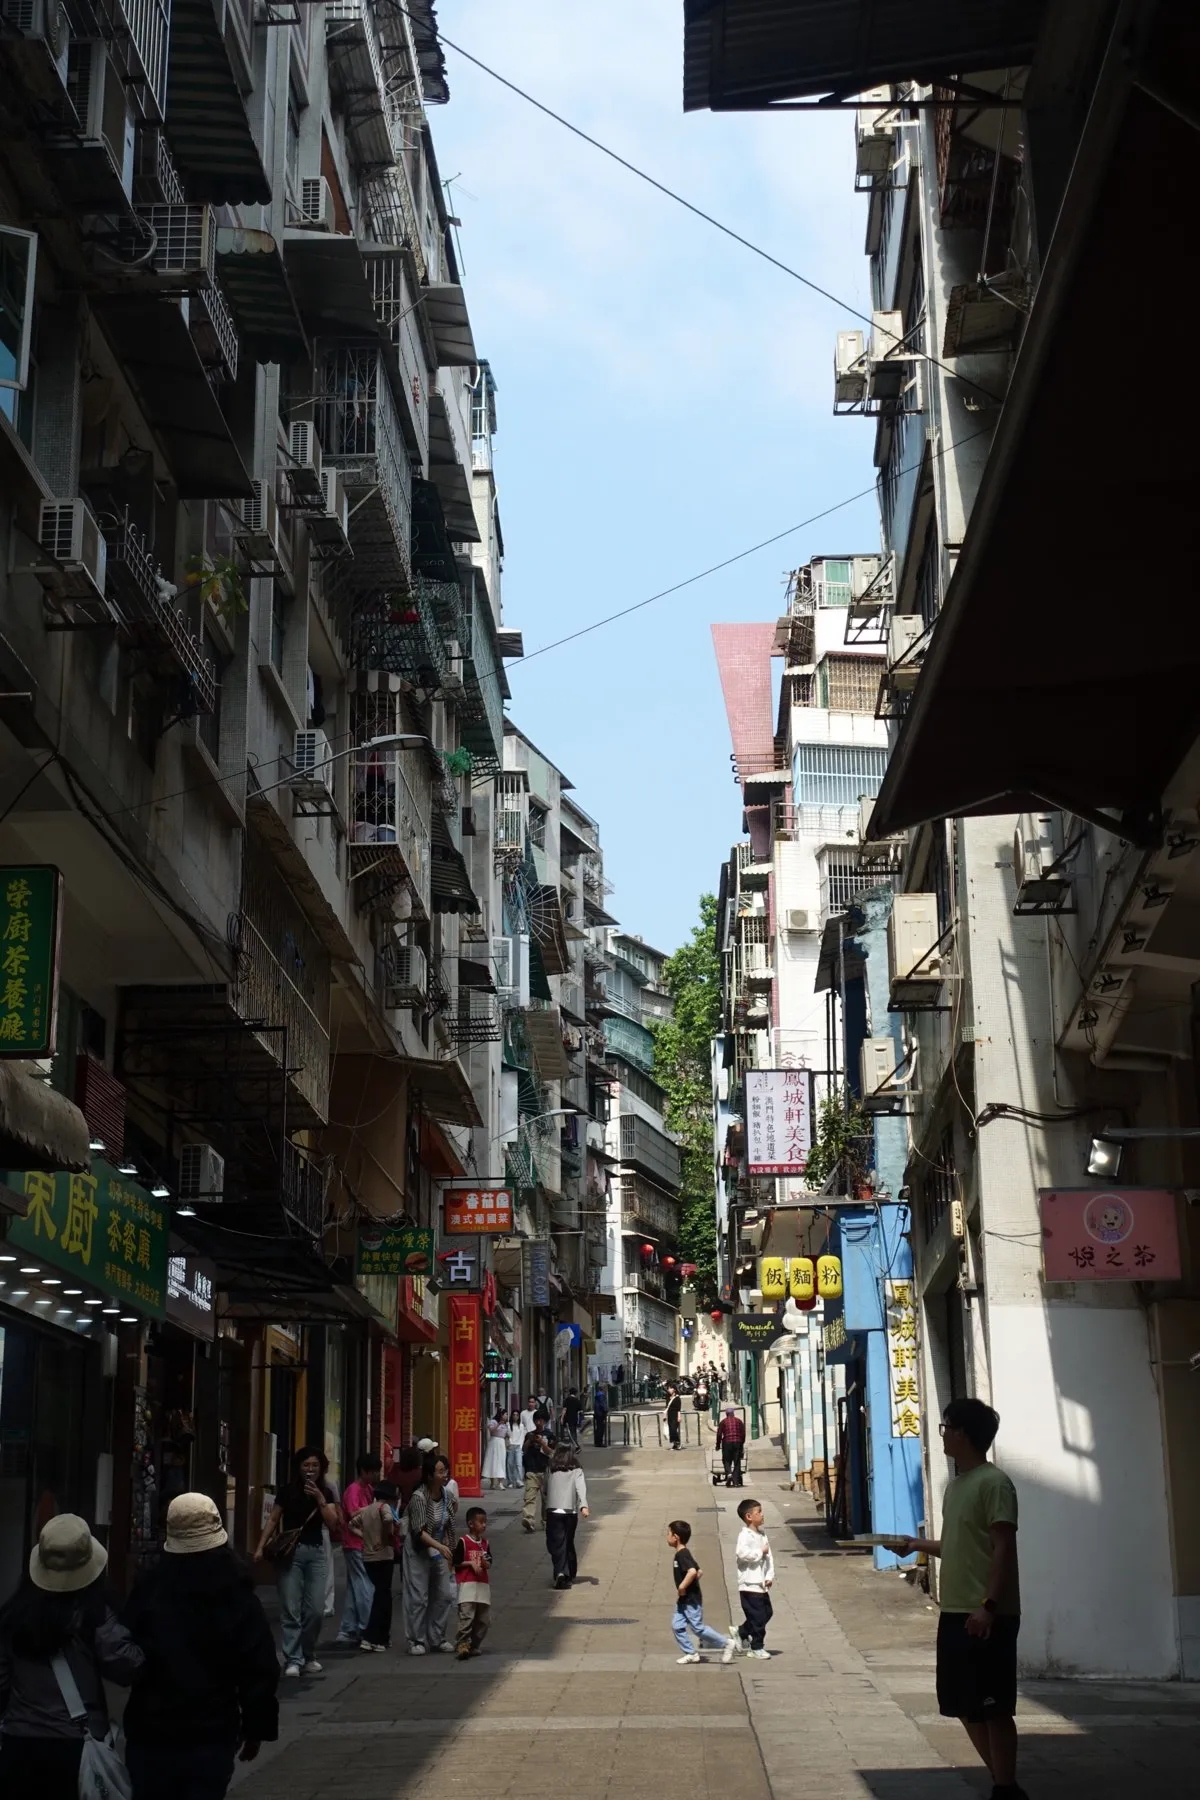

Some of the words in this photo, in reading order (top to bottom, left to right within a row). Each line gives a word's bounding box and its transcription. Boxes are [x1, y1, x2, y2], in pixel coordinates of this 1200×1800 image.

[782, 1071, 808, 1162] 鳳城軒美食
[445, 1251, 475, 1282] 古
[766, 1267, 784, 1286] 飯
[793, 1267, 811, 1288] 麵
[822, 1265, 840, 1286] 粉
[891, 1283, 921, 1436] 鳳城軒美食
